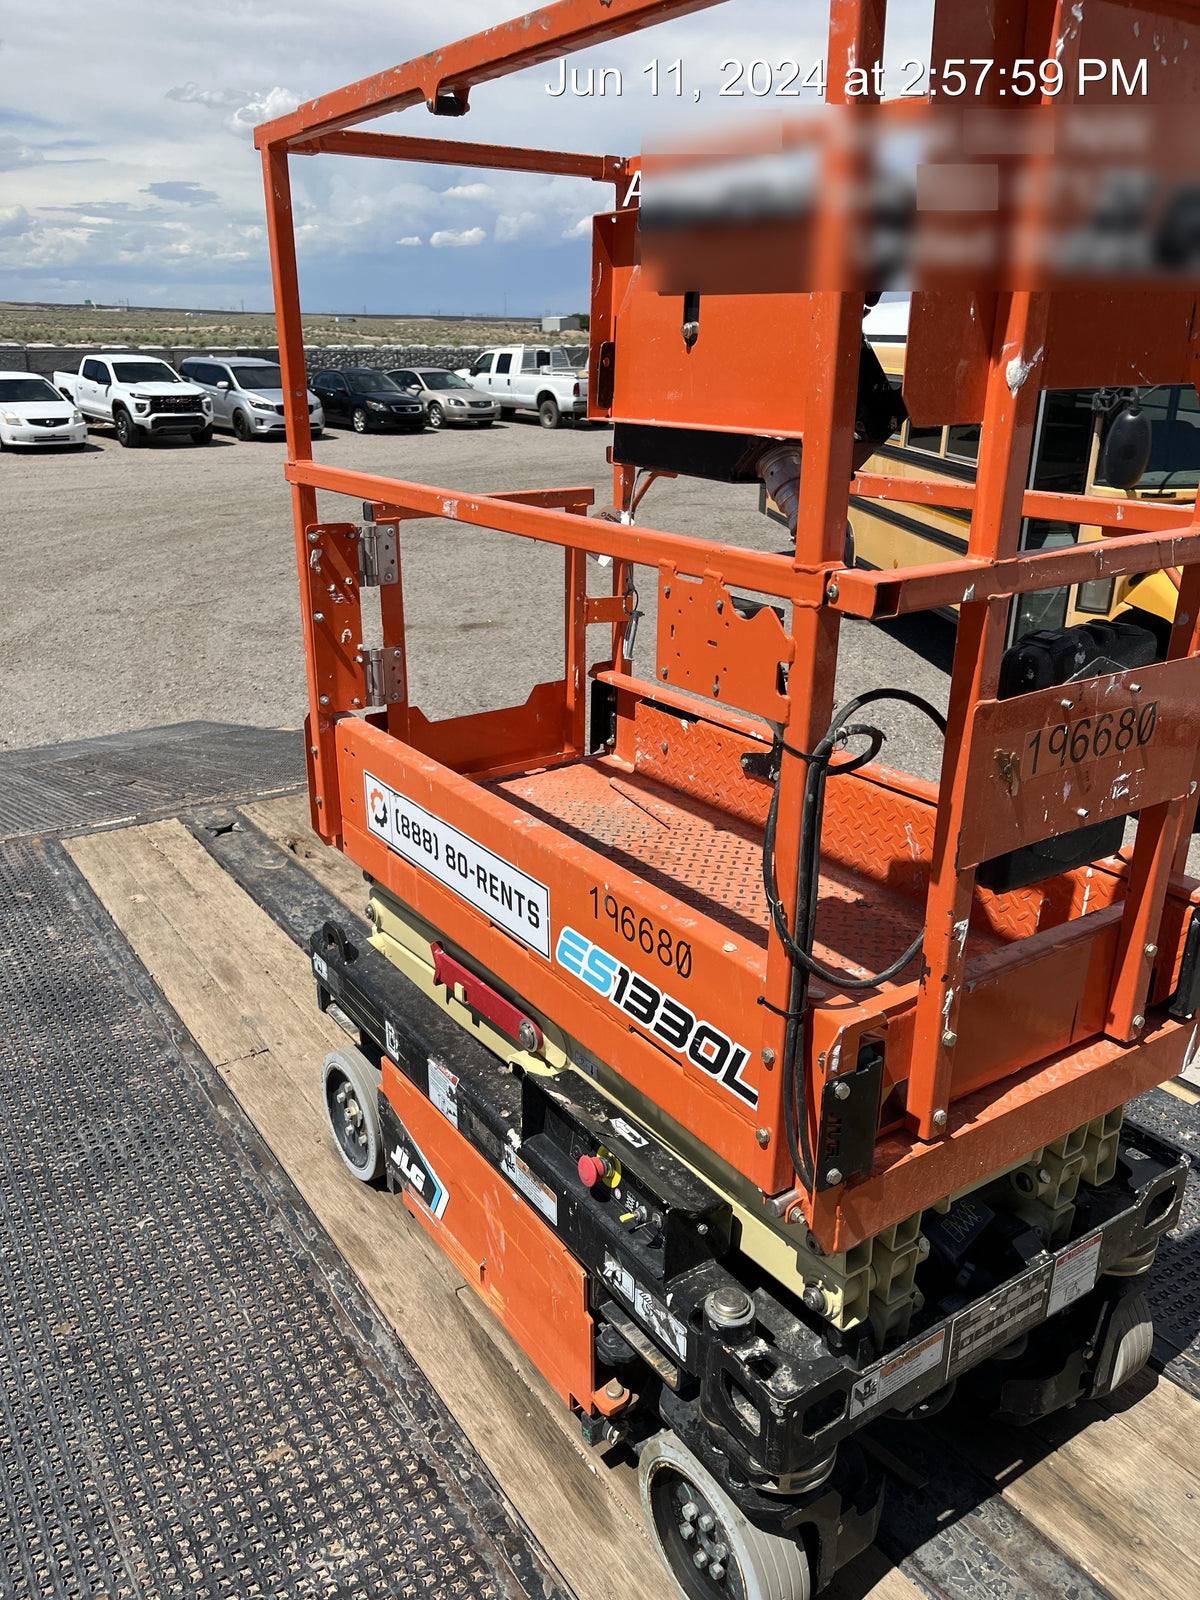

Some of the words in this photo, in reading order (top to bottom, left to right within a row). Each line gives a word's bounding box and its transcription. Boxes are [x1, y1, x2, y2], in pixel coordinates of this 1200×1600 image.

[1028, 701, 1158, 775] 196680
[394, 808, 439, 861] (888)
[445, 843, 540, 929] 80-RENTS
[589, 886, 692, 979] 196680
[557, 927, 759, 1107] ES1330L
[390, 1144, 426, 1193] JLG
